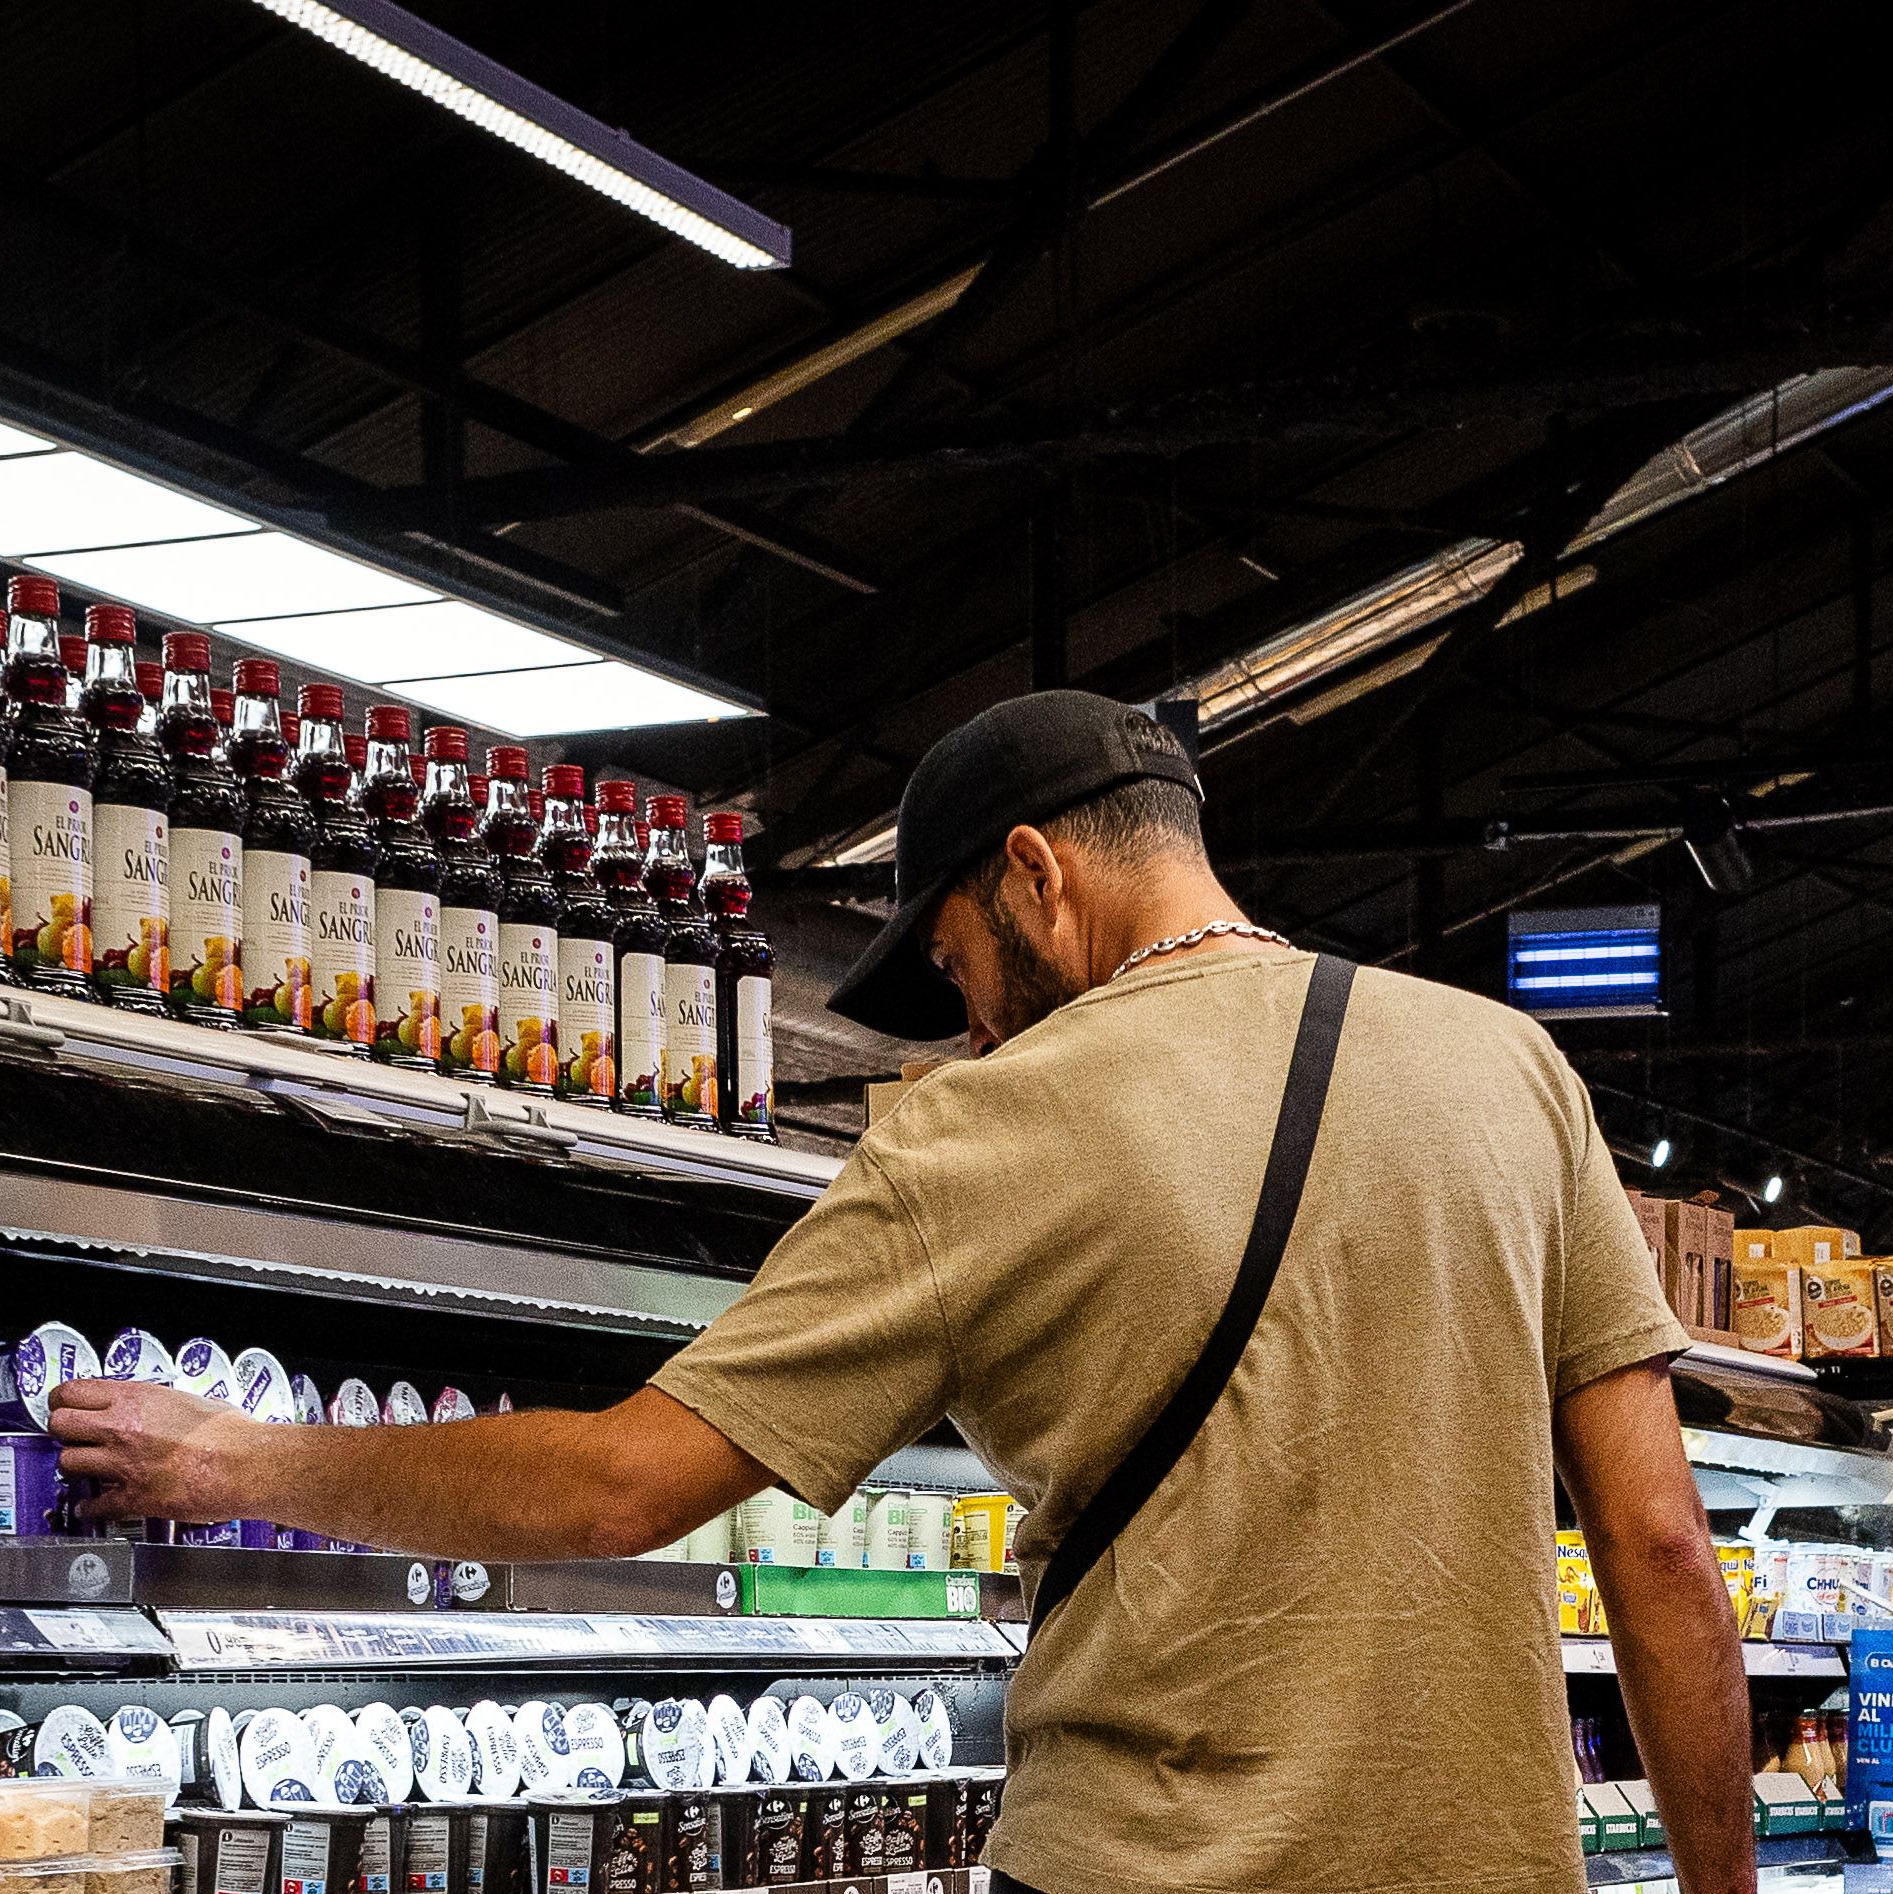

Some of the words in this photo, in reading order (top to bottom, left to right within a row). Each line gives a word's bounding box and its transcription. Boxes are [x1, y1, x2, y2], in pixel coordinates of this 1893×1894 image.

[33, 825, 92, 865] SANGRI
[189, 871, 242, 908] SANGRI
[319, 911, 374, 946] SANGRI
[946, 1587, 977, 1614] BIO
[1858, 1708, 1881, 1723] AL
[570, 1736, 604, 1751] ESPRESSO
[769, 1863, 796, 1875] ESPRESS
[609, 1878, 636, 1890] PRESSO
